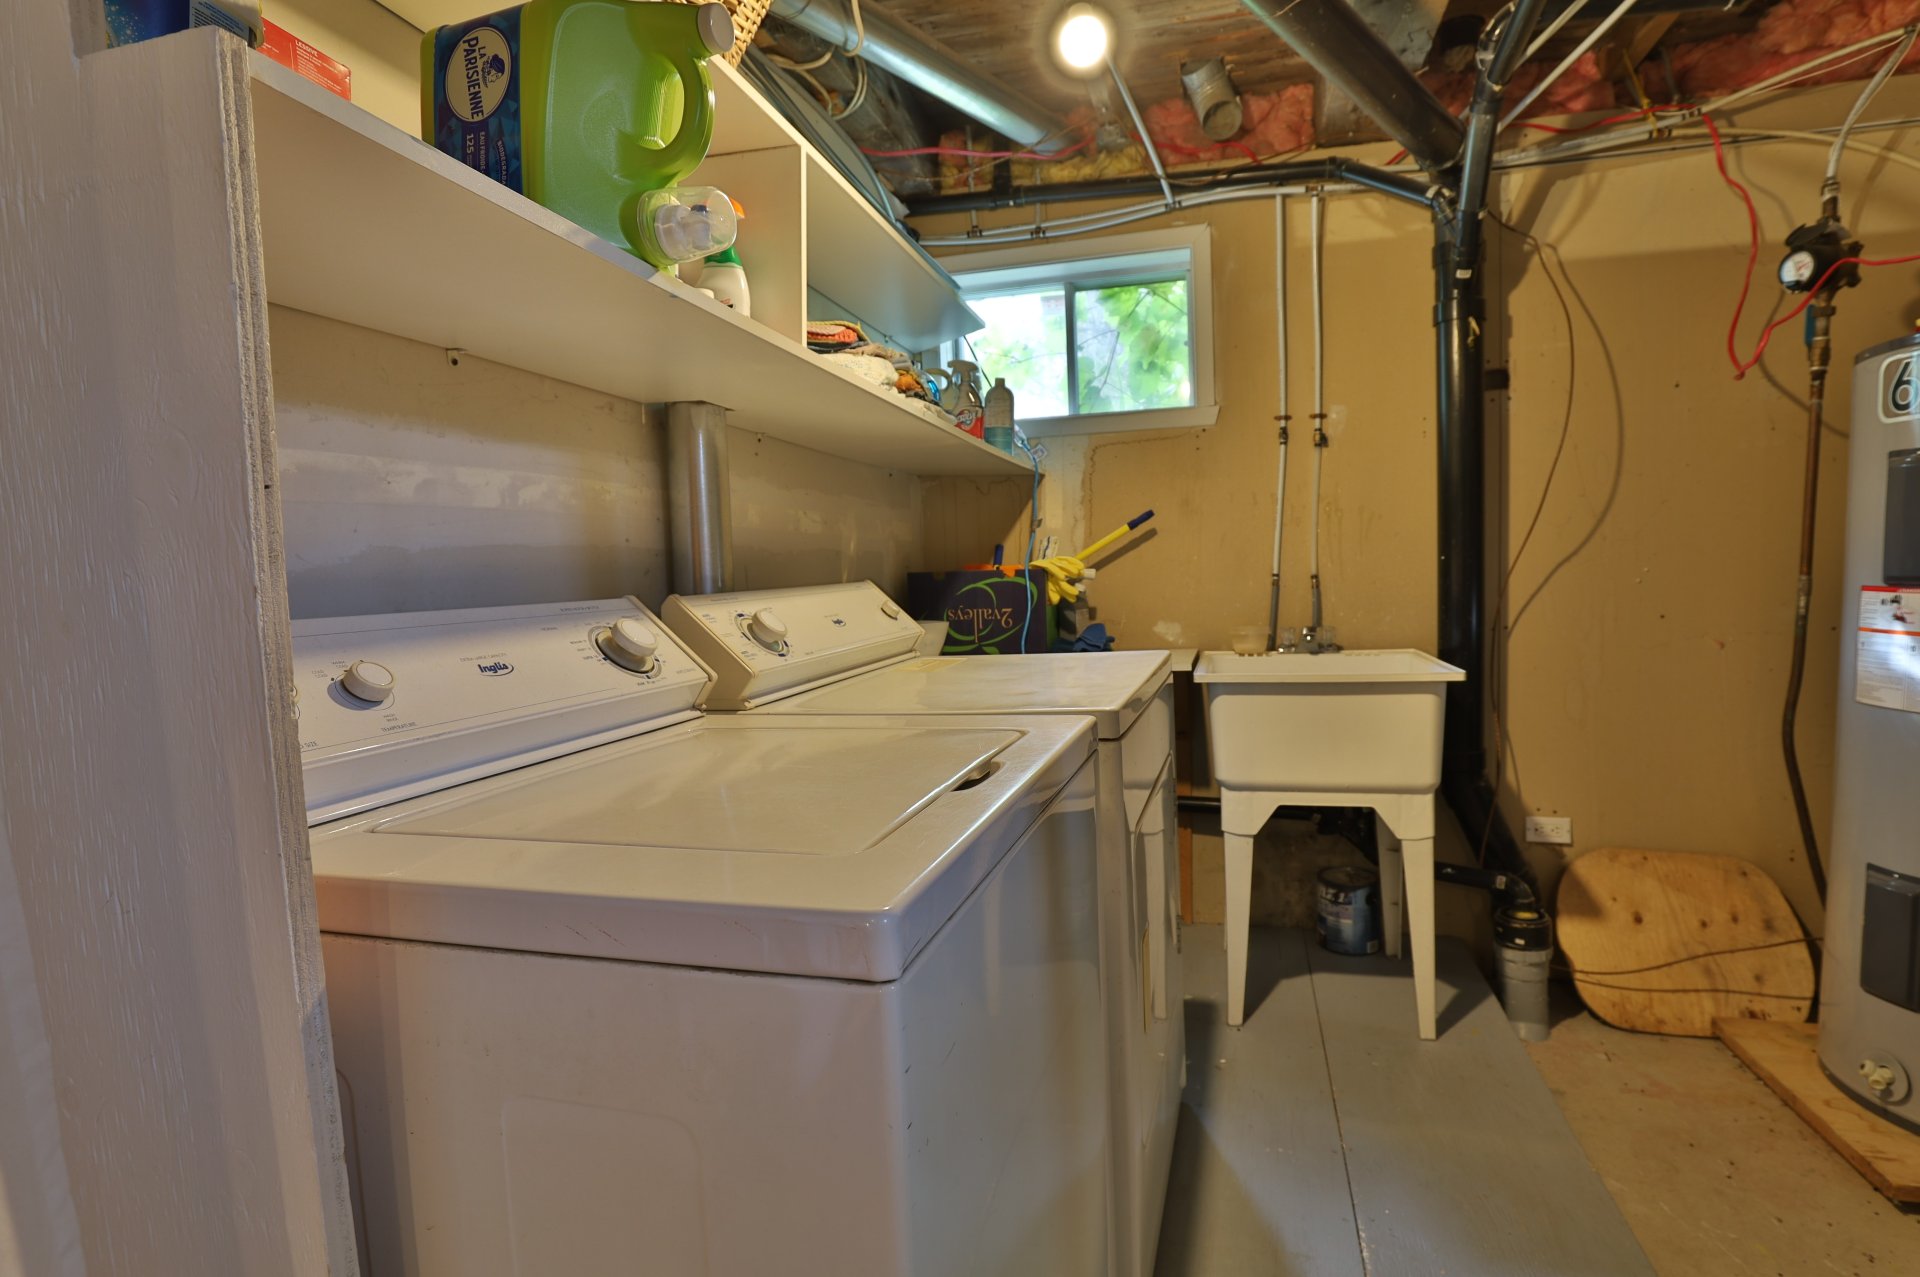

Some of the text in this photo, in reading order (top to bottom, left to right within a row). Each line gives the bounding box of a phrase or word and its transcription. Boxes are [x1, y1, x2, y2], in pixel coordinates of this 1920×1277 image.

[477, 46, 487, 60] LA
[463, 35, 485, 120] PARISIENNE
[464, 134, 475, 154] 125
[477, 661, 509, 674] Inglis
